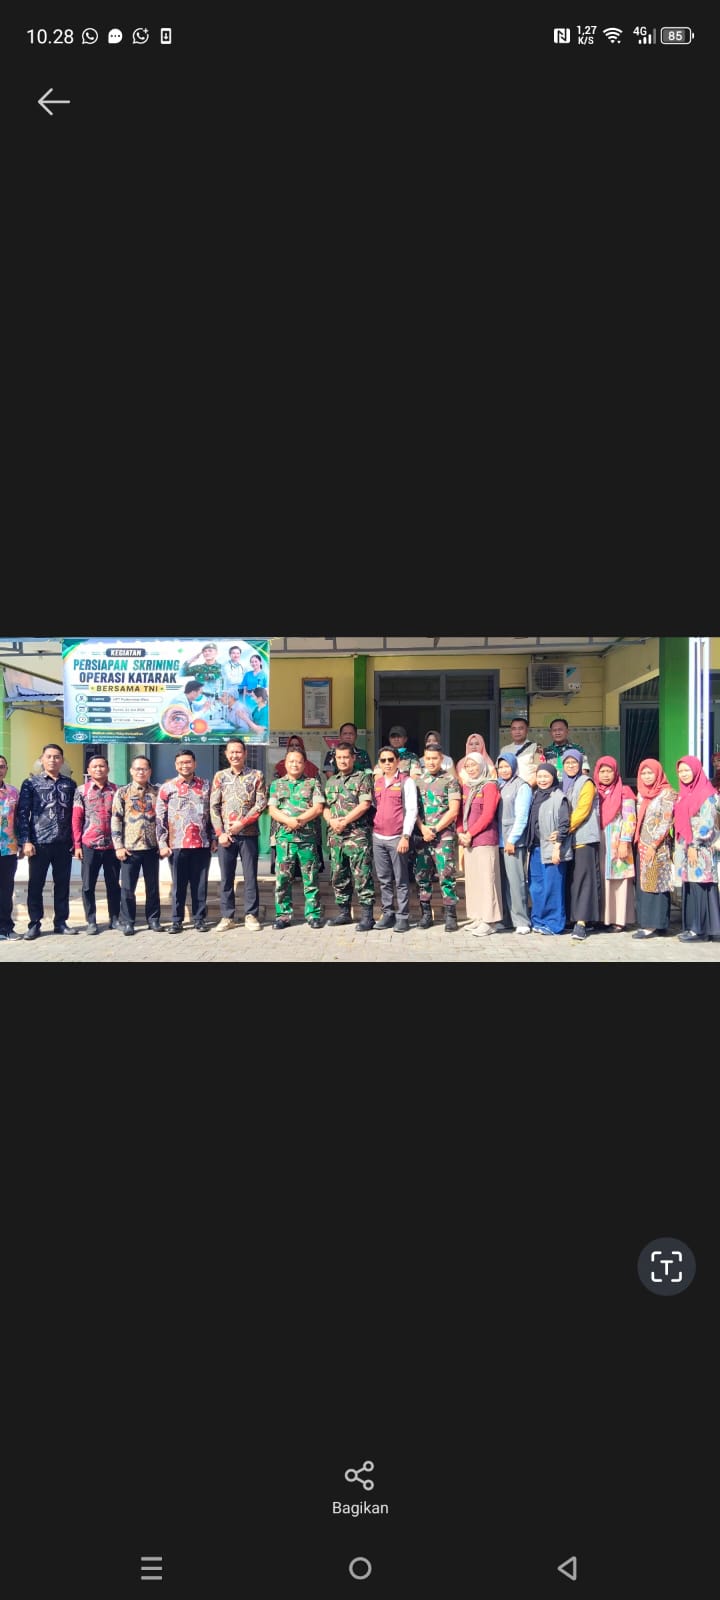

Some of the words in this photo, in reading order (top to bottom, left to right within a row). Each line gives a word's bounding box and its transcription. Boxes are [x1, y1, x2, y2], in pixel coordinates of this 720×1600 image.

[576, 25, 597, 36] 1,27
[633, 26, 647, 36] 4G
[668, 31, 683, 41] 85
[26, 28, 74, 45] 10.28
[577, 36, 594, 46] K/S
[110, 649, 142, 657] KEGIATAN
[73, 659, 128, 671] PERSIAPAN
[133, 659, 180, 671] SKRINING
[79, 672, 125, 684] OPERASI
[128, 672, 177, 684] KATARAK
[332, 1501, 389, 1517] Bagikan
